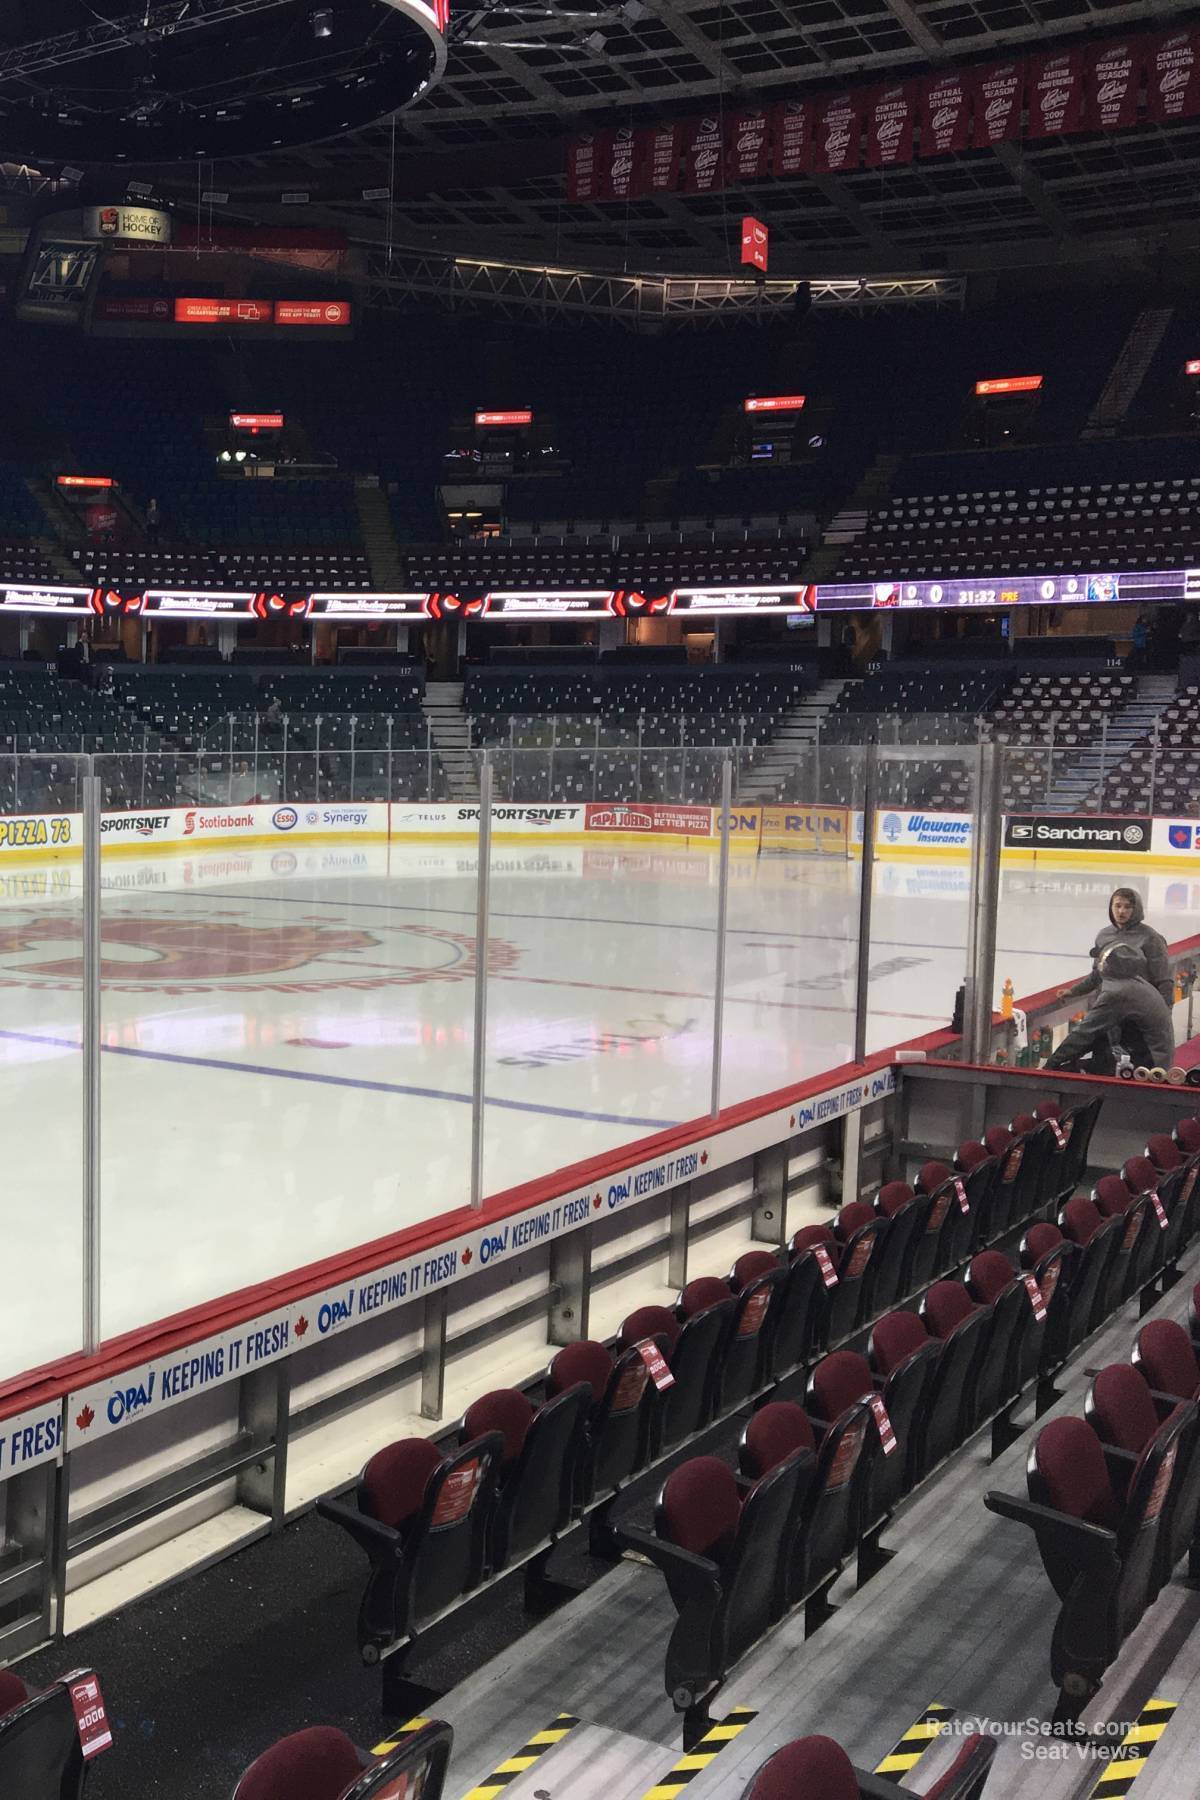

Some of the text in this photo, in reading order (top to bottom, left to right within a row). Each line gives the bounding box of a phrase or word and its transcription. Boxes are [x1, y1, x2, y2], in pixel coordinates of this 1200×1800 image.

[1157, 48, 1193, 61] CENTRAL
[1095, 60, 1132, 72] REGULAR
[1157, 56, 1193, 70] DIVISION
[1097, 69, 1129, 80] SEASON
[929, 87, 964, 101] CENTRAL
[984, 87, 1015, 98] SEASON
[1164, 91, 1185, 102] 2010
[875, 102, 907, 114] CENTRAL
[929, 95, 962, 109] DIVISION
[1101, 103, 1120, 113] 2010
[875, 109, 907, 122] DIVISION
[122, 213, 146, 225] HOME
[122, 222, 162, 236] HOCKEY
[907, 587, 916, 599] 0
[929, 585, 942, 603] 0
[1001, 591, 1019, 602] PRE
[1041, 580, 1055, 599] 0
[1066, 580, 1078, 593] 0
[868, 662, 881, 670] 115
[1106, 658, 1121, 667] 114
[100, 816, 170, 833] SPORTSNET
[199, 815, 254, 830] Scotiabank
[276, 813, 294, 823] Esso
[323, 812, 367, 826] Synergy
[654, 819, 686, 828] BETTER
[785, 815, 841, 833] RUN
[908, 815, 972, 833] Wawane
[51, 817, 72, 843] 73
[1037, 826, 1121, 841] Sandman
[917, 832, 967, 844] Insurance
[607, 1151, 698, 1210] OPA! KEEPING IT FRESH
[479, 1194, 591, 1265] OPA! KEEPING IT FRESH
[317, 1250, 457, 1334] OPA! KEEPING IT FRESH
[106, 1319, 289, 1425] OPA! KEEPING IT FRESH
